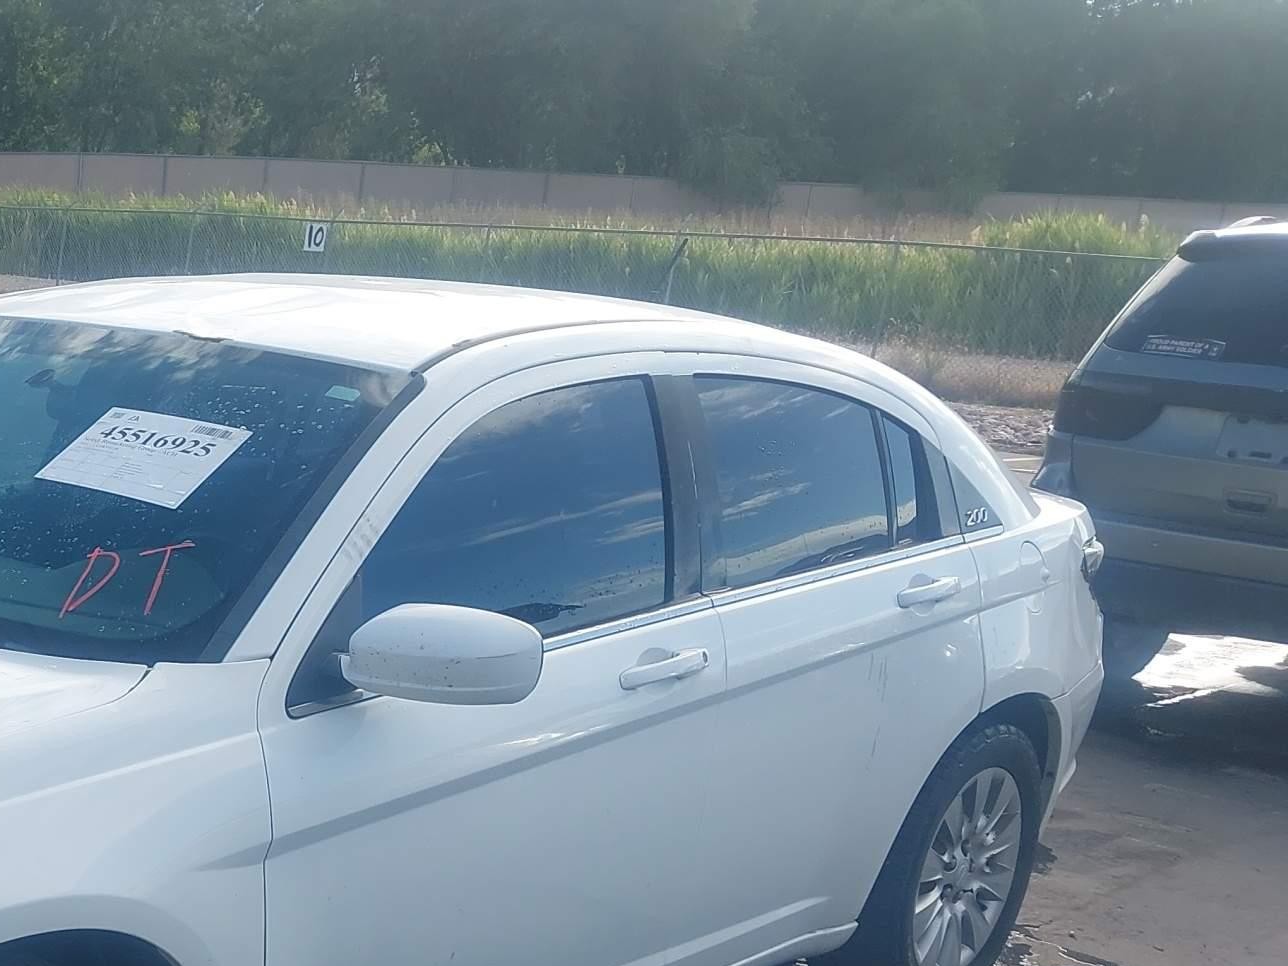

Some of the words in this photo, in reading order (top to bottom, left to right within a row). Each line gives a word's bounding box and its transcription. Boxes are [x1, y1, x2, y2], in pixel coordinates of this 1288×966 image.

[307, 224, 325, 249] 10
[99, 425, 217, 458] 45516925
[965, 506, 988, 527] 200
